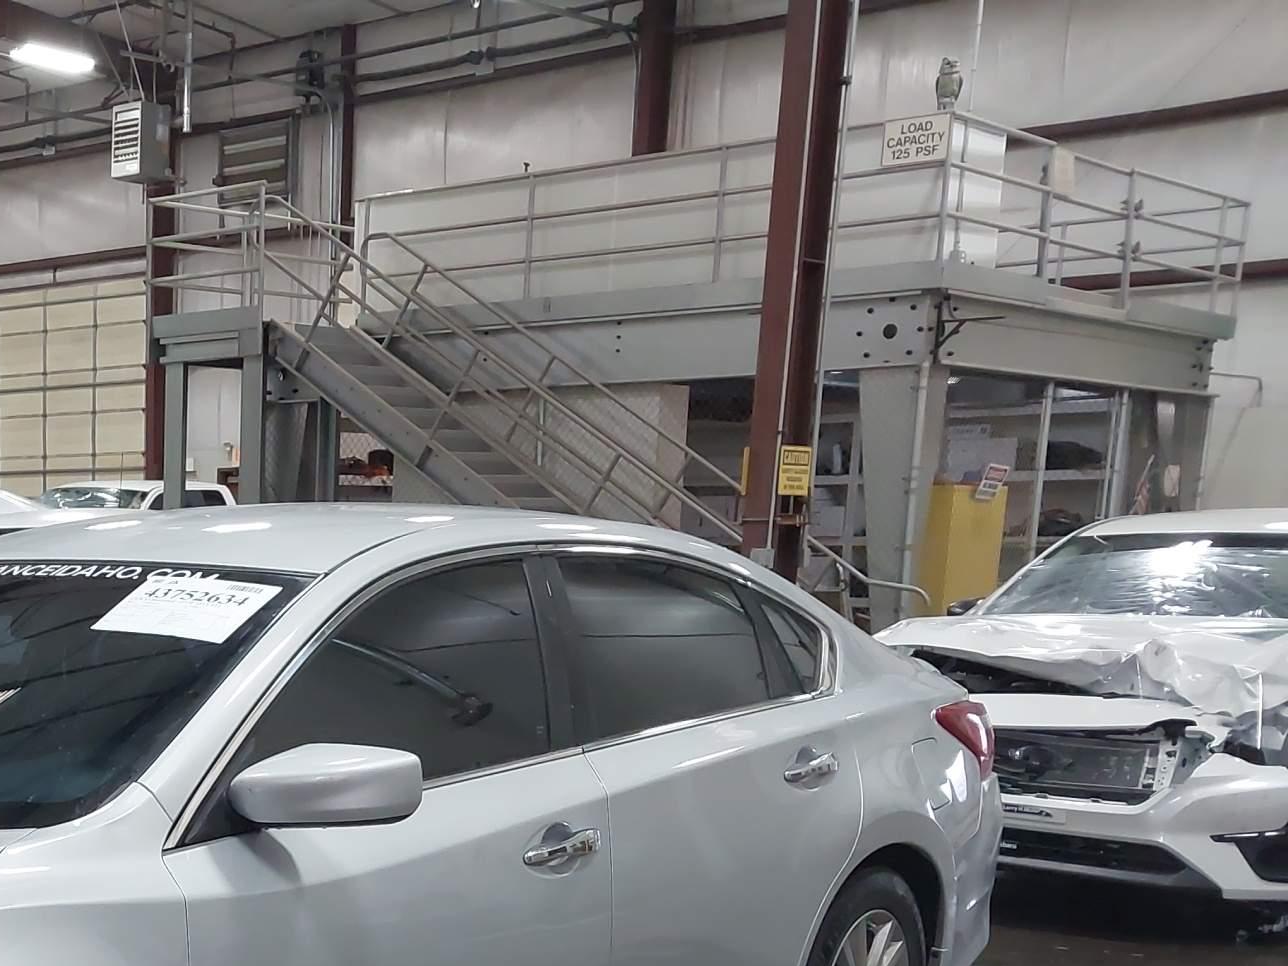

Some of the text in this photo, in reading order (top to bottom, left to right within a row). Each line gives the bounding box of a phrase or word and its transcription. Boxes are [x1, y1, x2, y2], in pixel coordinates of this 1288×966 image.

[901, 120, 933, 134] LOAD
[887, 132, 944, 148] CAPACITY
[891, 144, 940, 160] 125 PSF
[144, 587, 249, 606] 43752634
